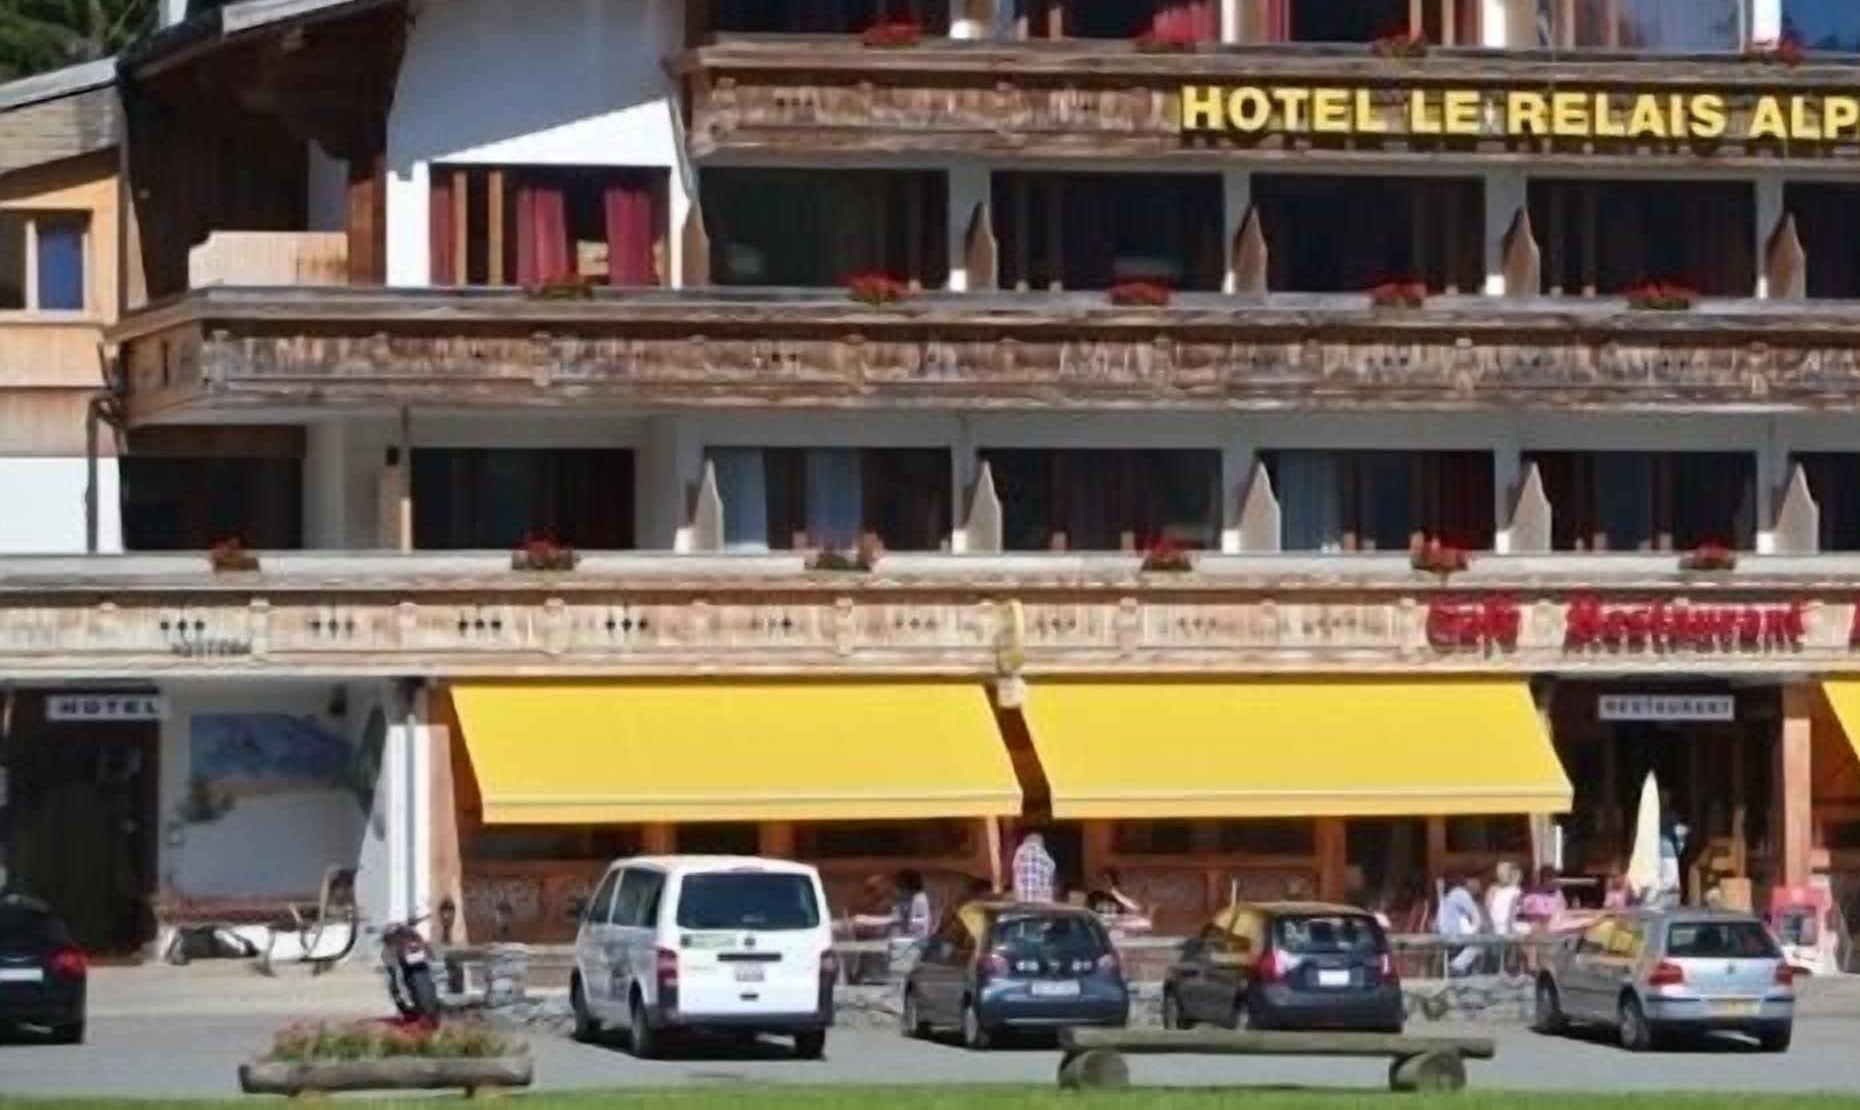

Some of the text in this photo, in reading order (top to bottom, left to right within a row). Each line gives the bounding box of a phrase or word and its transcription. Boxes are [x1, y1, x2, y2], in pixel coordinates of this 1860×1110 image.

[1181, 85, 1388, 133] HOTEL
[1411, 88, 1482, 134] LE
[1507, 90, 1726, 138] RELAIS
[59, 697, 158, 715] HOTEL
[1604, 699, 1730, 715] RESTAURANT
